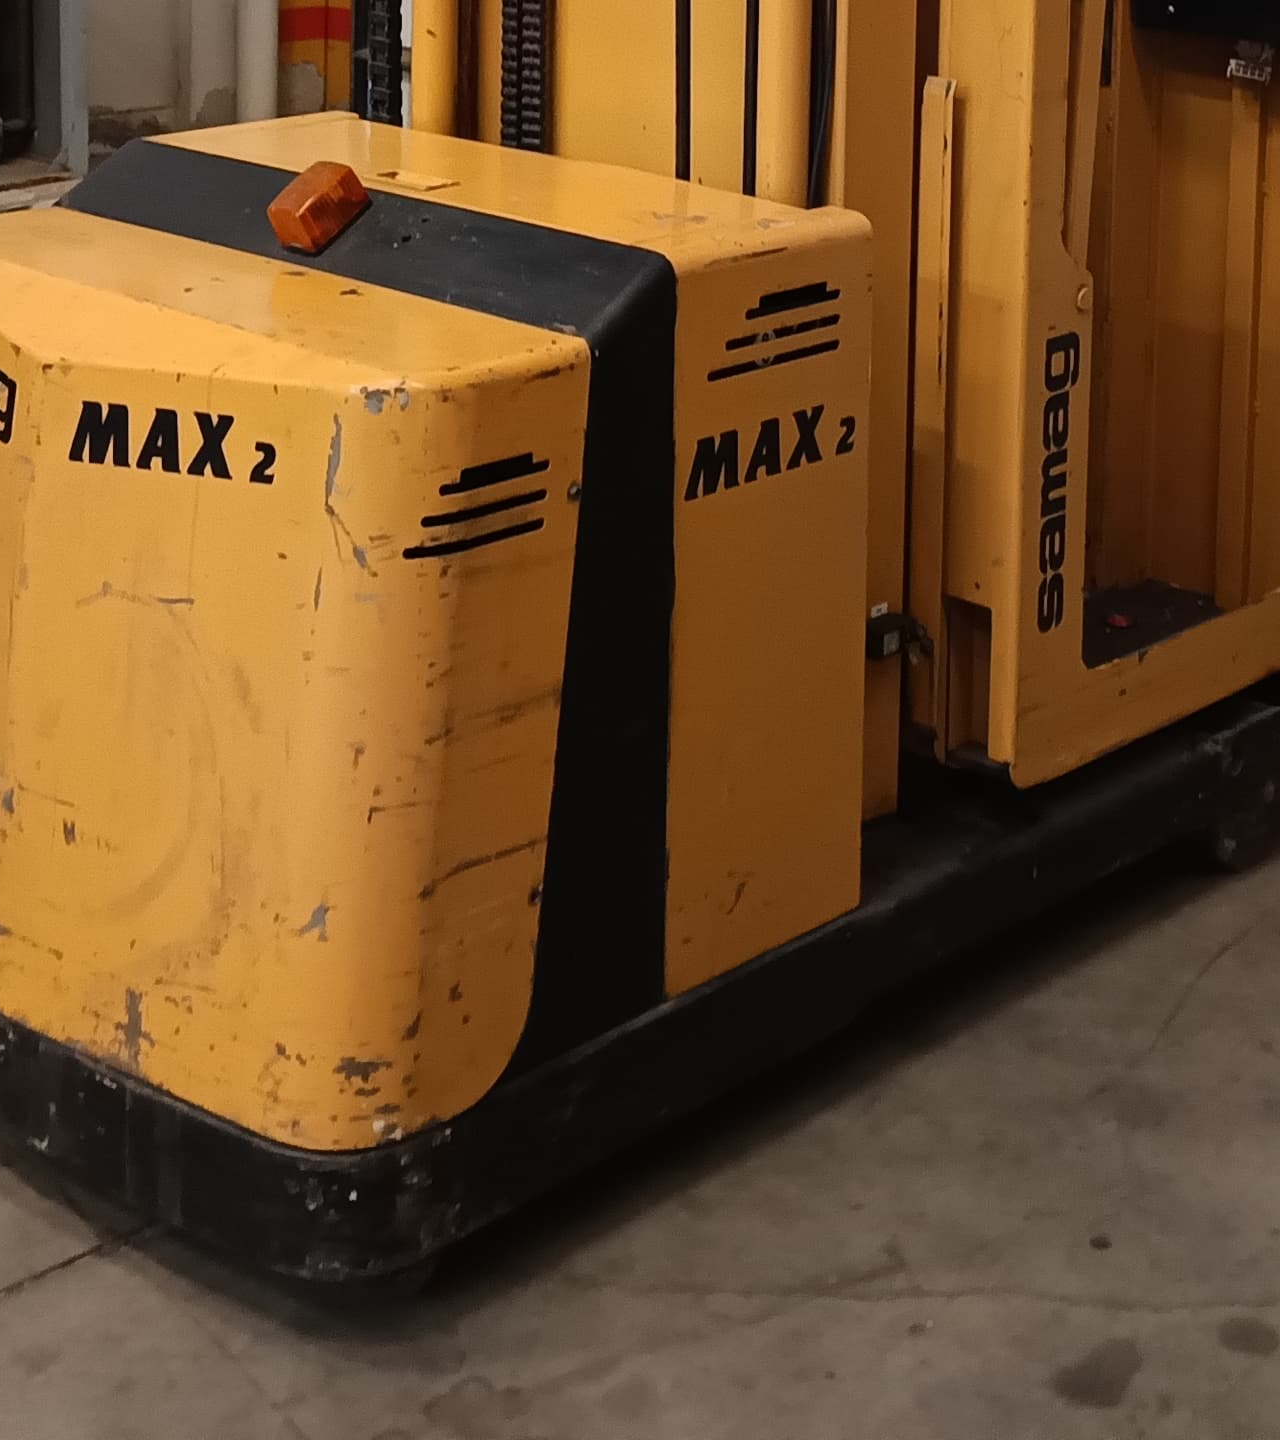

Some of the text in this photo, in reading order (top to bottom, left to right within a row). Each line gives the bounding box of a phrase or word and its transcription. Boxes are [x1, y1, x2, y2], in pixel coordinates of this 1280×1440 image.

[68, 400, 278, 485] MAX 2
[683, 404, 856, 502] MAX 2
[1037, 331, 1081, 634] samag
